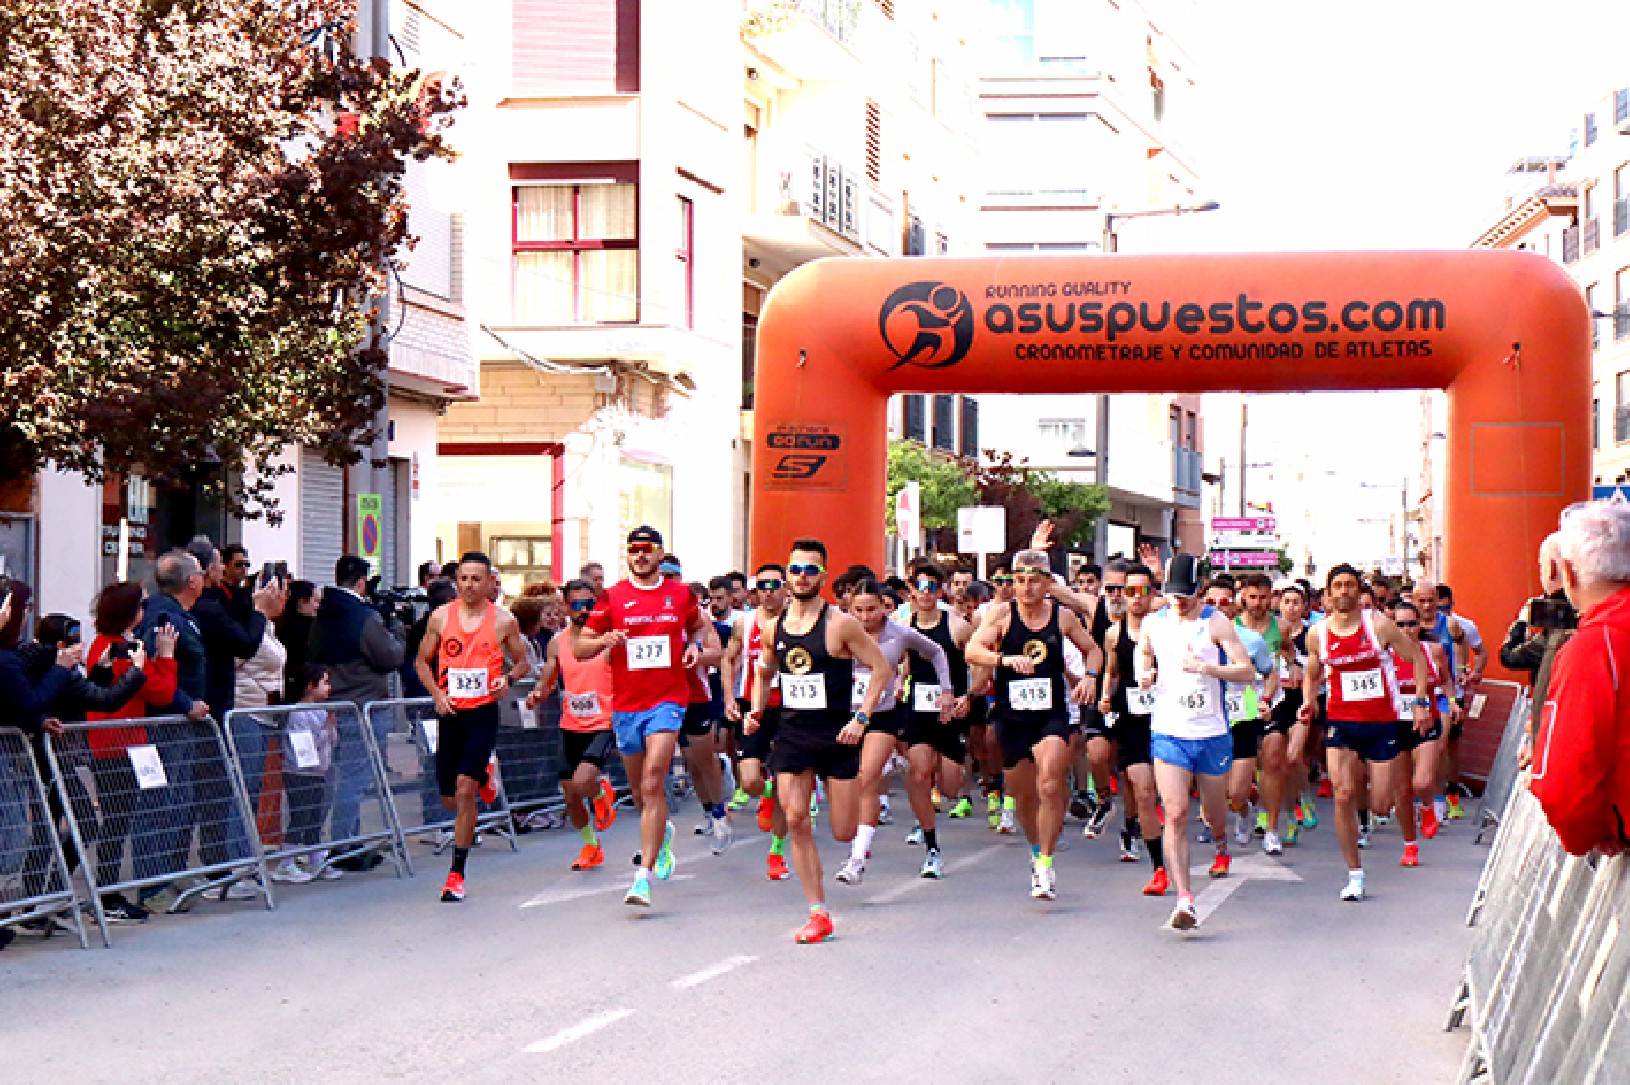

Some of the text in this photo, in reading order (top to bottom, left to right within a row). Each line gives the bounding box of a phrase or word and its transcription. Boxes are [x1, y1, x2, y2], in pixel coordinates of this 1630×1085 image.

[984, 292, 1446, 342] asuspuestos.com
[1014, 339, 1433, 361] CRONOMETRAJE Y COMUNIDAD DE ATLETAS
